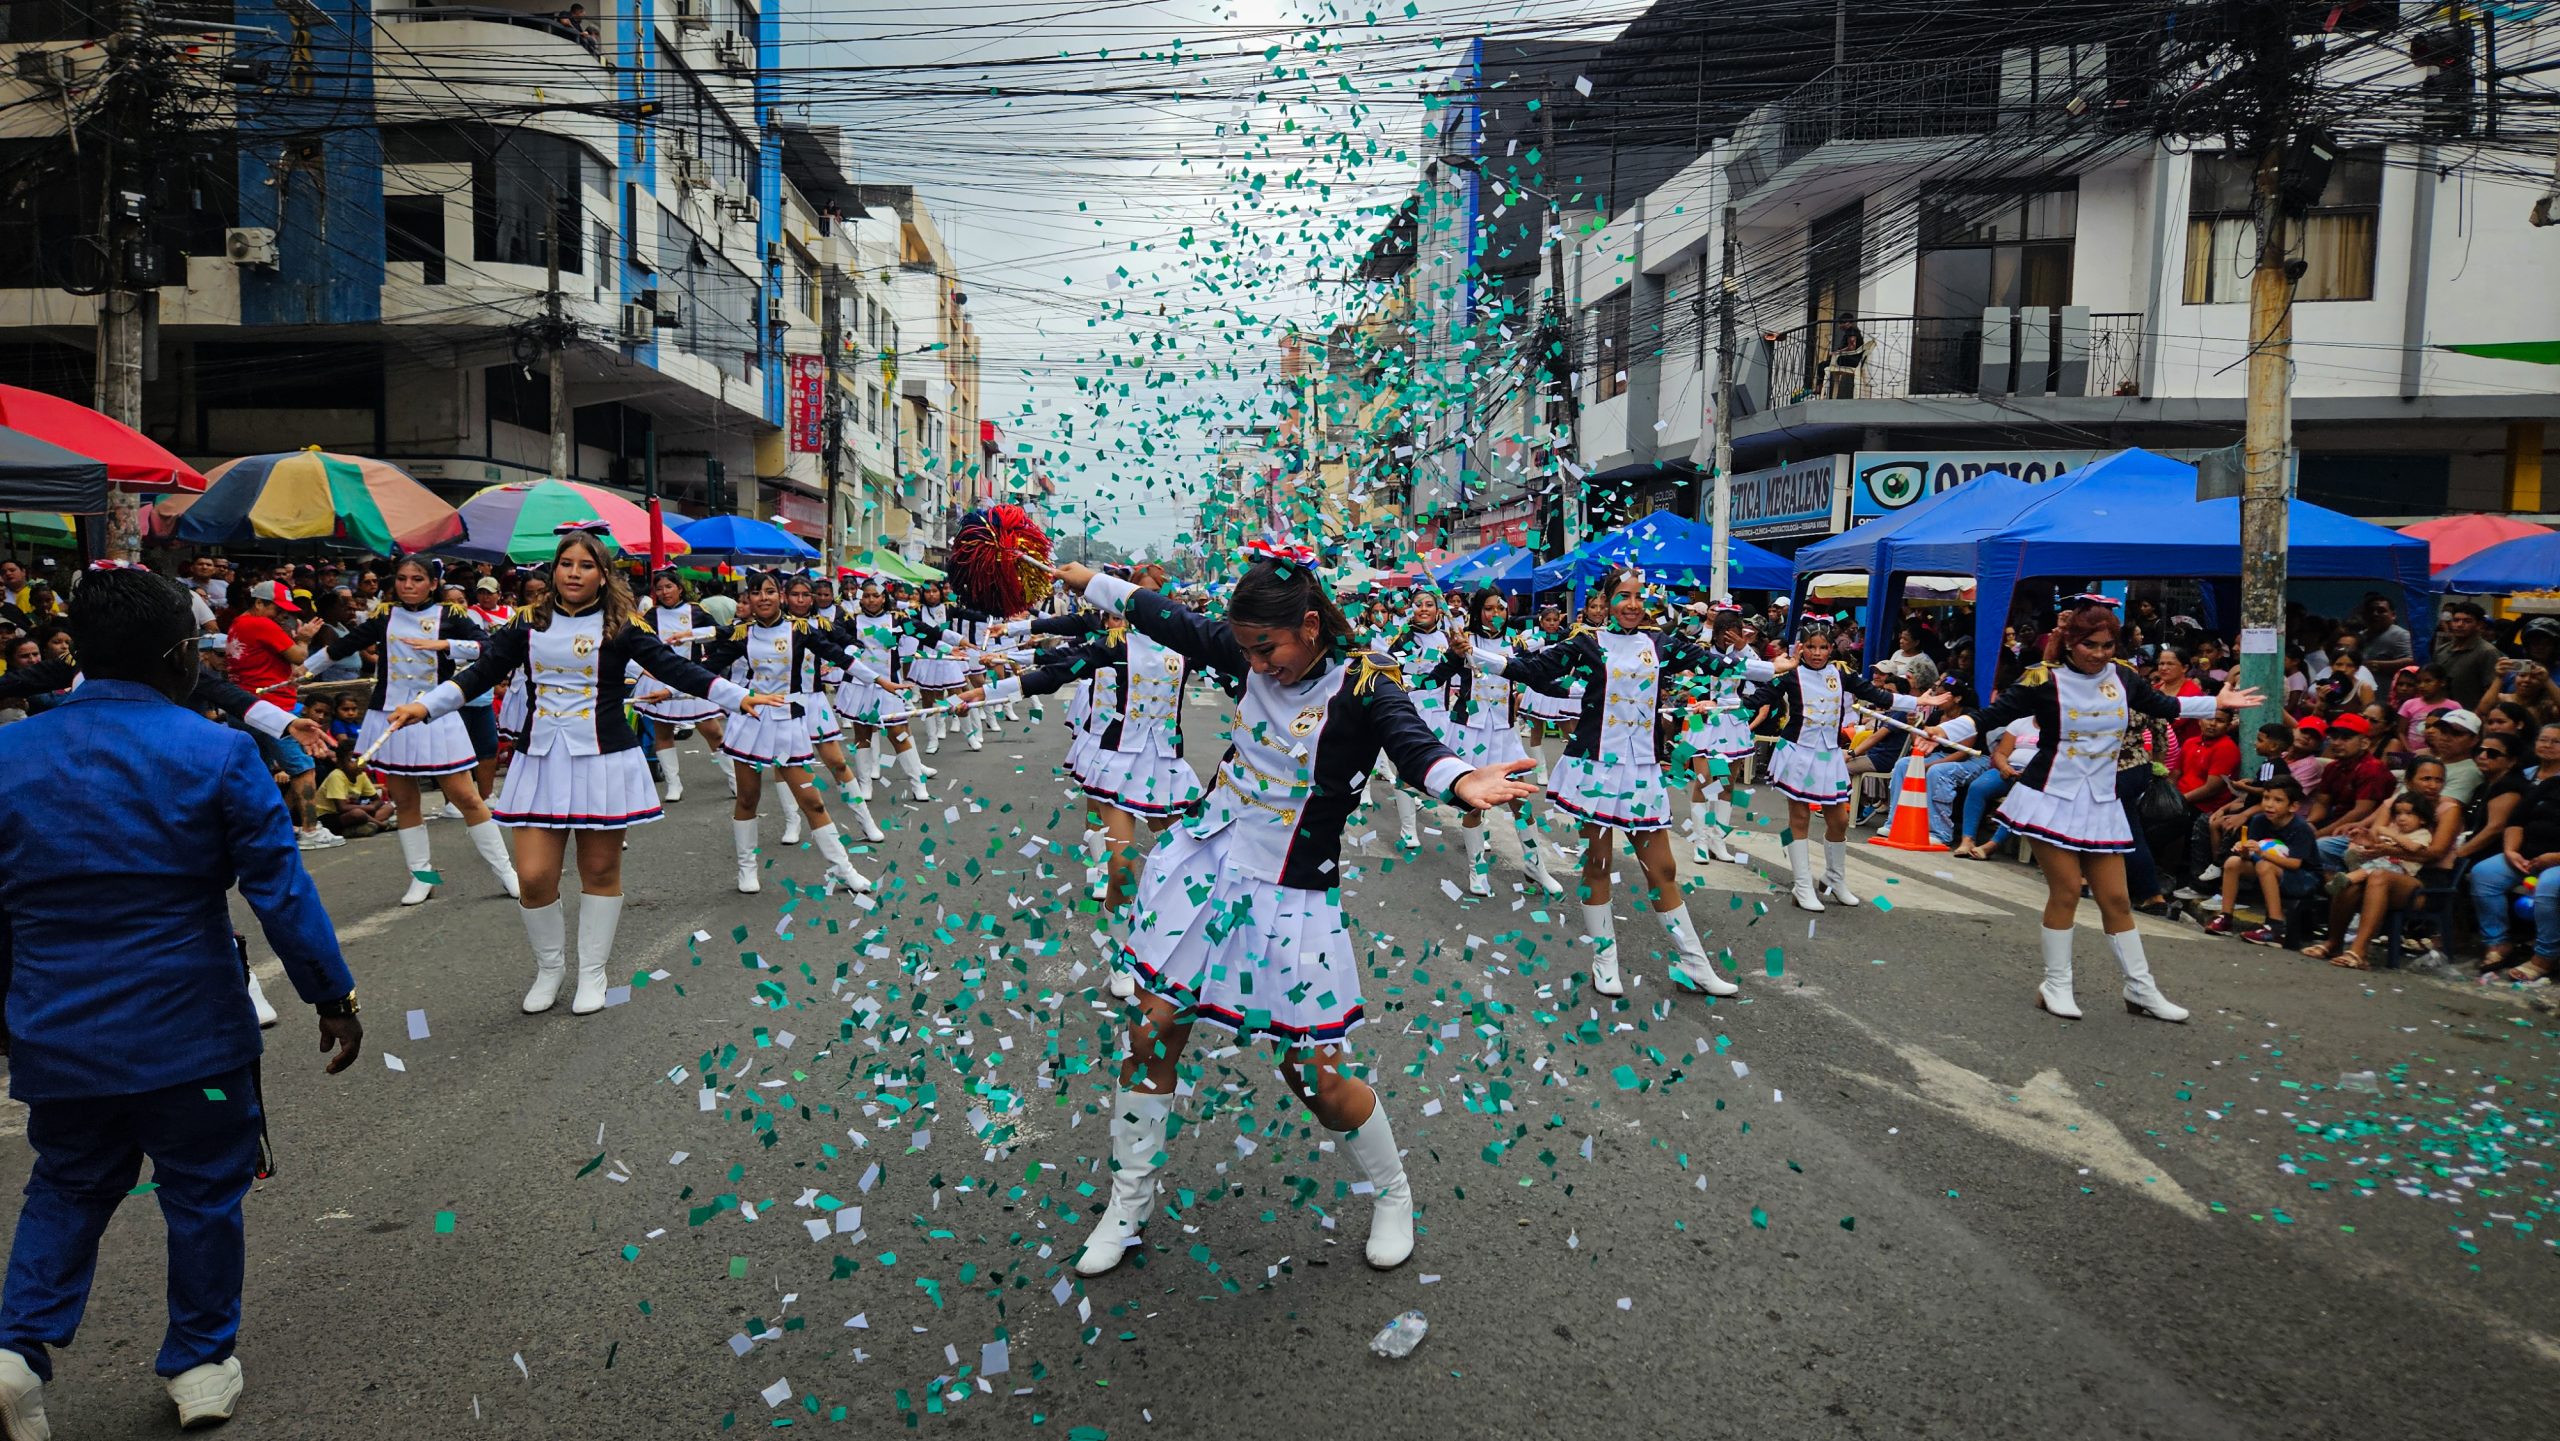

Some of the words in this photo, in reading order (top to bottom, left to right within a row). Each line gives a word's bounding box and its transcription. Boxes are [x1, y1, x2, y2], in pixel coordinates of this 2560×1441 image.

[792, 357, 805, 451] farmacias
[808, 381, 819, 446] suiza
[1730, 480, 1761, 521] PTICA
[1764, 466, 1831, 517] MEGALENS
[1934, 461, 2067, 495] OPC
